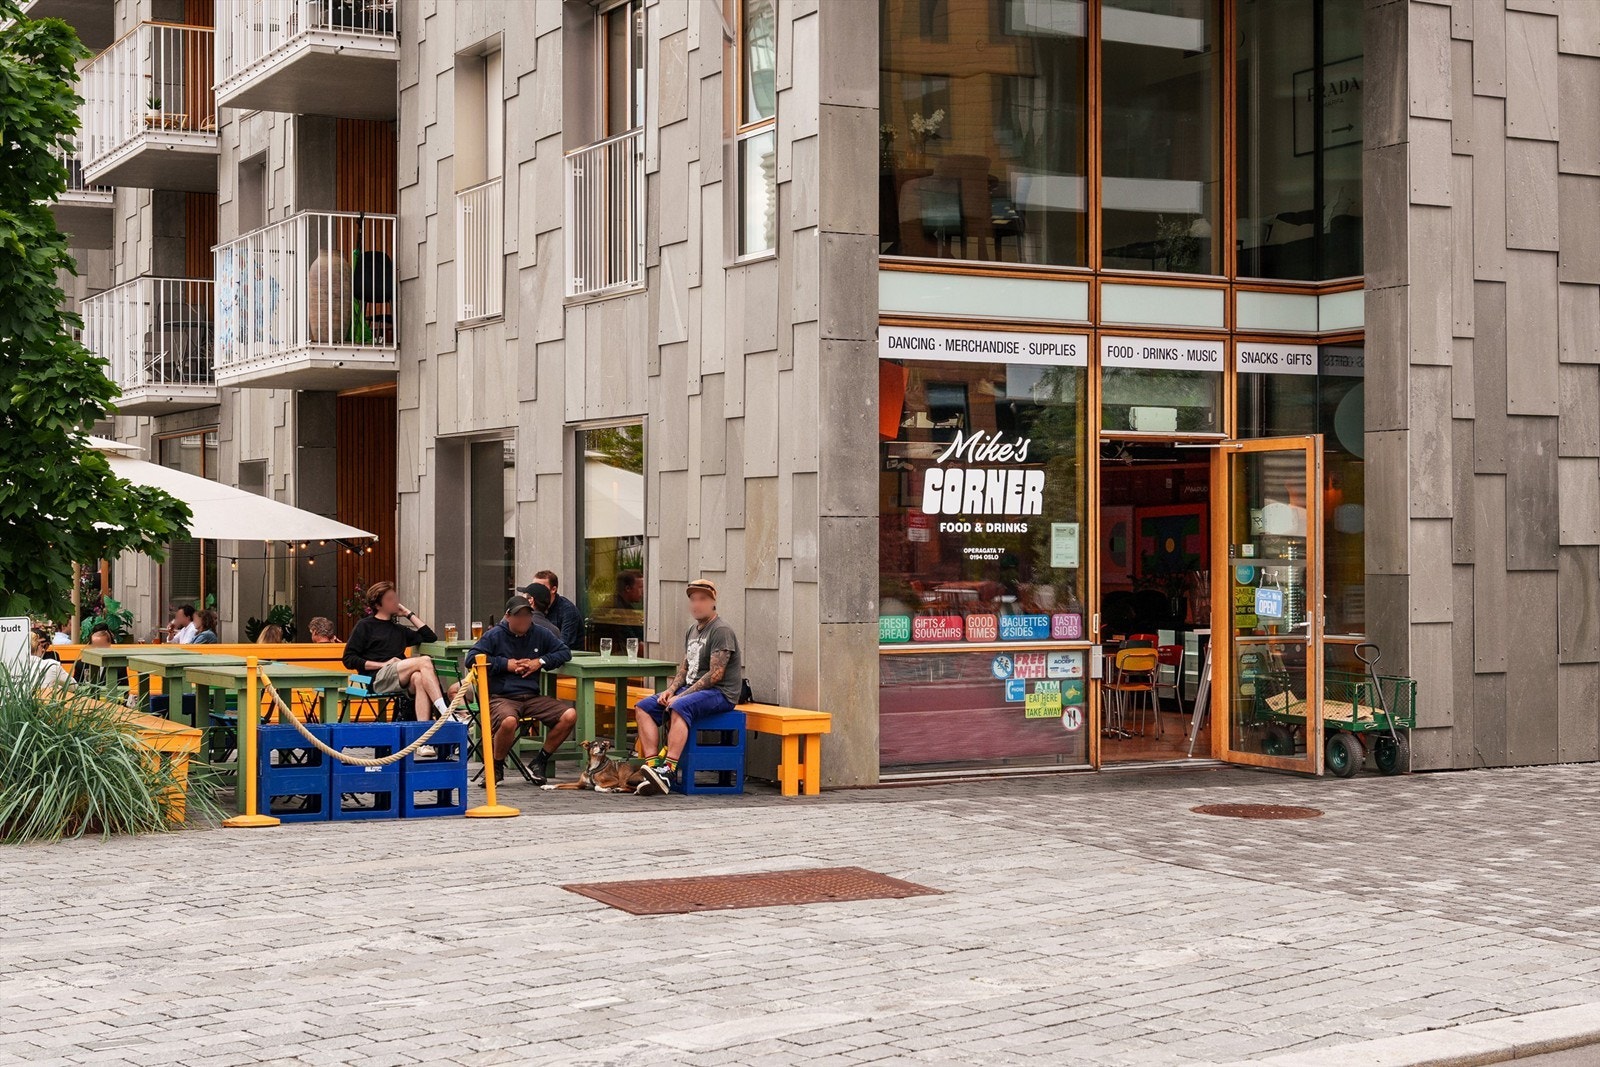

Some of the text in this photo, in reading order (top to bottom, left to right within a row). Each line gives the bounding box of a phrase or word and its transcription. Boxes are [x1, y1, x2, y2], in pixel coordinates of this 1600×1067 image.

[888, 336, 1076, 357] DANCING MERCHANDISE SUPPLIES
[1107, 345, 1218, 362] FOOD DRINKS MUSIC
[1241, 351, 1313, 366] SNACKS GIFTS
[937, 430, 1031, 464] Mike's
[922, 467, 1046, 515] CORNER
[940, 522, 972, 533] FOOD
[974, 522, 983, 533] &
[986, 522, 1028, 533] DRINKS
[879, 618, 907, 629] FRESH
[915, 619, 938, 629] GIFTS
[968, 617, 993, 628] GOOD
[1001, 616, 1048, 627] BAGUETTES
[1054, 616, 1079, 626] TASTY
[0, 625, 21, 633] budt
[879, 629, 908, 639] BREAD
[915, 628, 961, 639] SOUVENIRS
[968, 627, 996, 638] TIMES
[1054, 626, 1078, 636] SIDES
[1014, 653, 1045, 665] FREE
[1014, 665, 1045, 678] WI-FI
[1035, 681, 1060, 690] ATM
[1028, 693, 1058, 703] EAT HERE
[1026, 707, 1061, 717] TAKE AWAY
